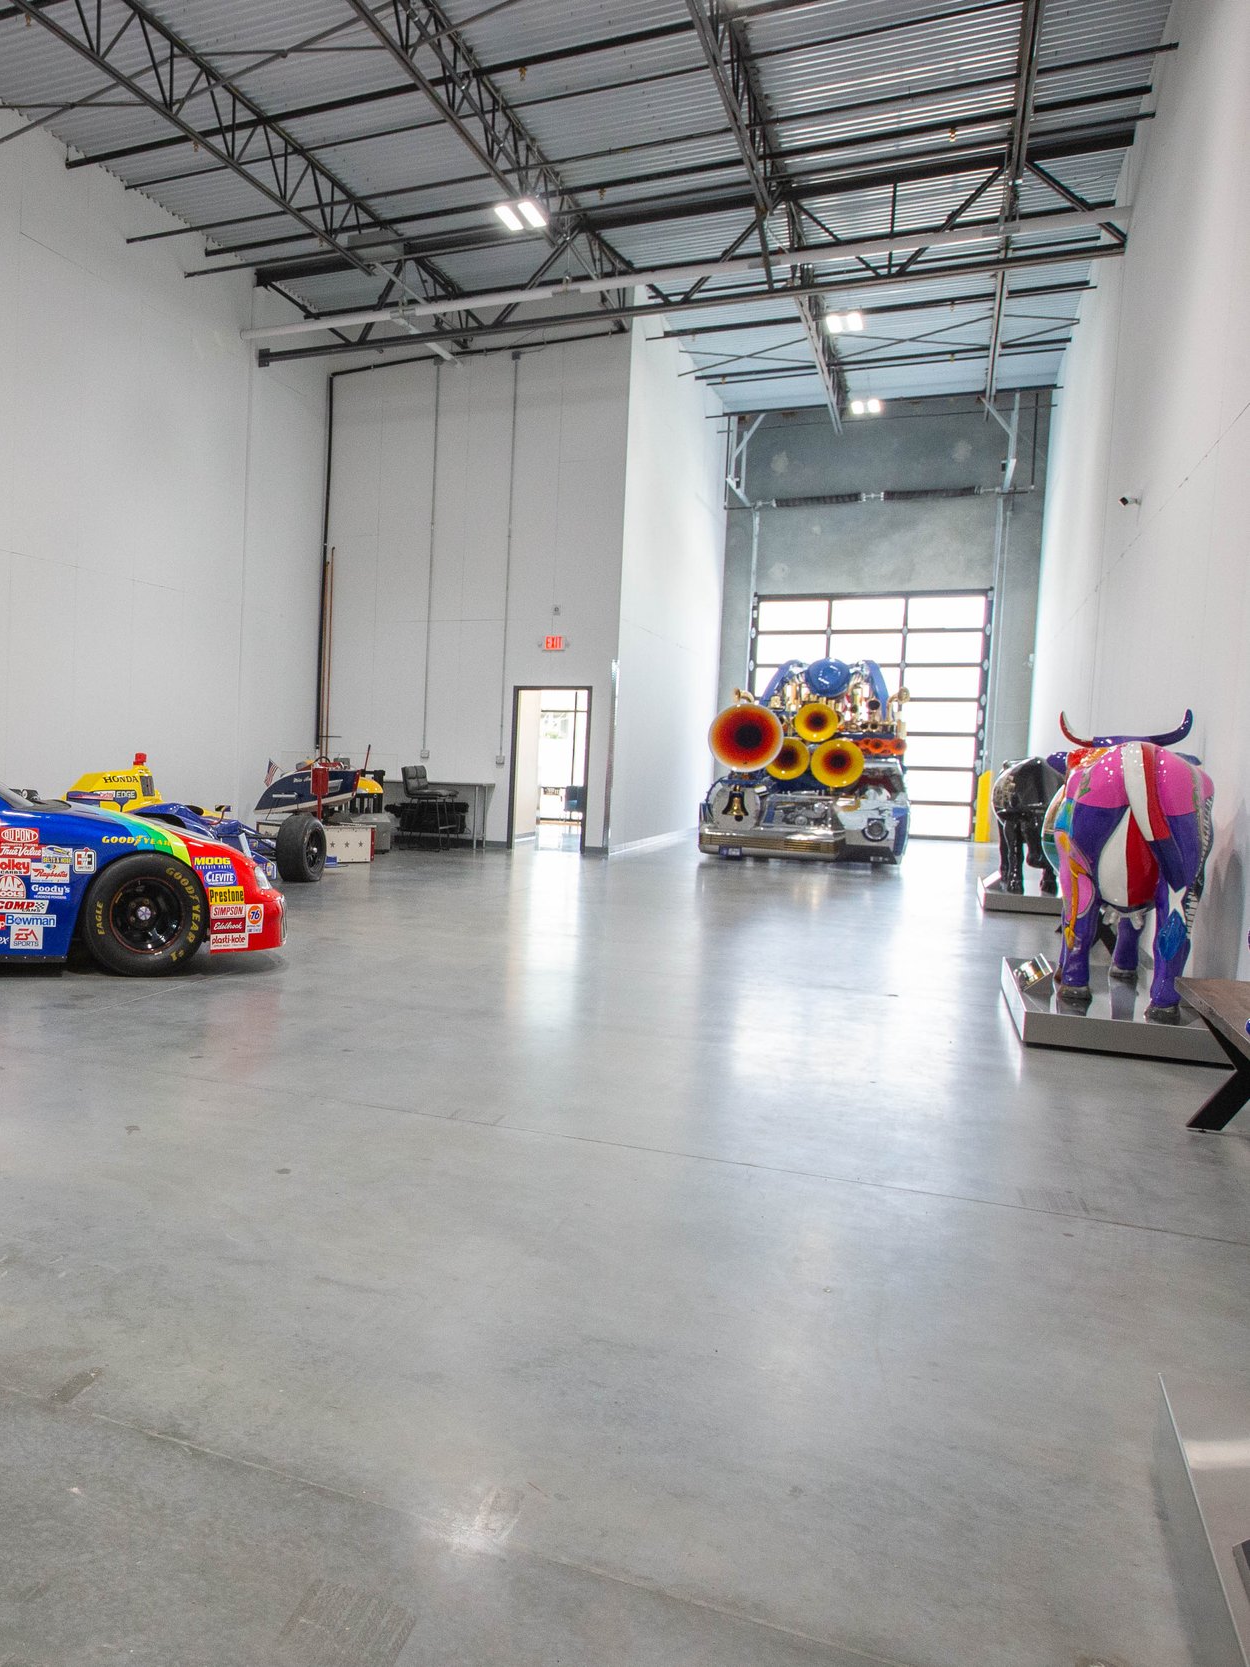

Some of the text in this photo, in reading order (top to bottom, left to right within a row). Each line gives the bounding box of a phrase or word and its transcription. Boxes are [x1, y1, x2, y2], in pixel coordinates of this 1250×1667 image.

[545, 636, 565, 649] EXIT
[102, 775, 139, 783] HONDA
[116, 790, 136, 798] EDGE
[194, 857, 231, 866] MOOG
[205, 871, 234, 882] CLEVITE
[31, 884, 70, 894] Goody's
[209, 889, 244, 902] Prestone
[166, 867, 201, 943] GOODYEAR
[213, 906, 244, 916] SIMPSON
[250, 910, 260, 920] 76
[6, 914, 56, 926] Bowman
[95, 900, 105, 935] EAGLE
[212, 934, 246, 946] plasti-kote
